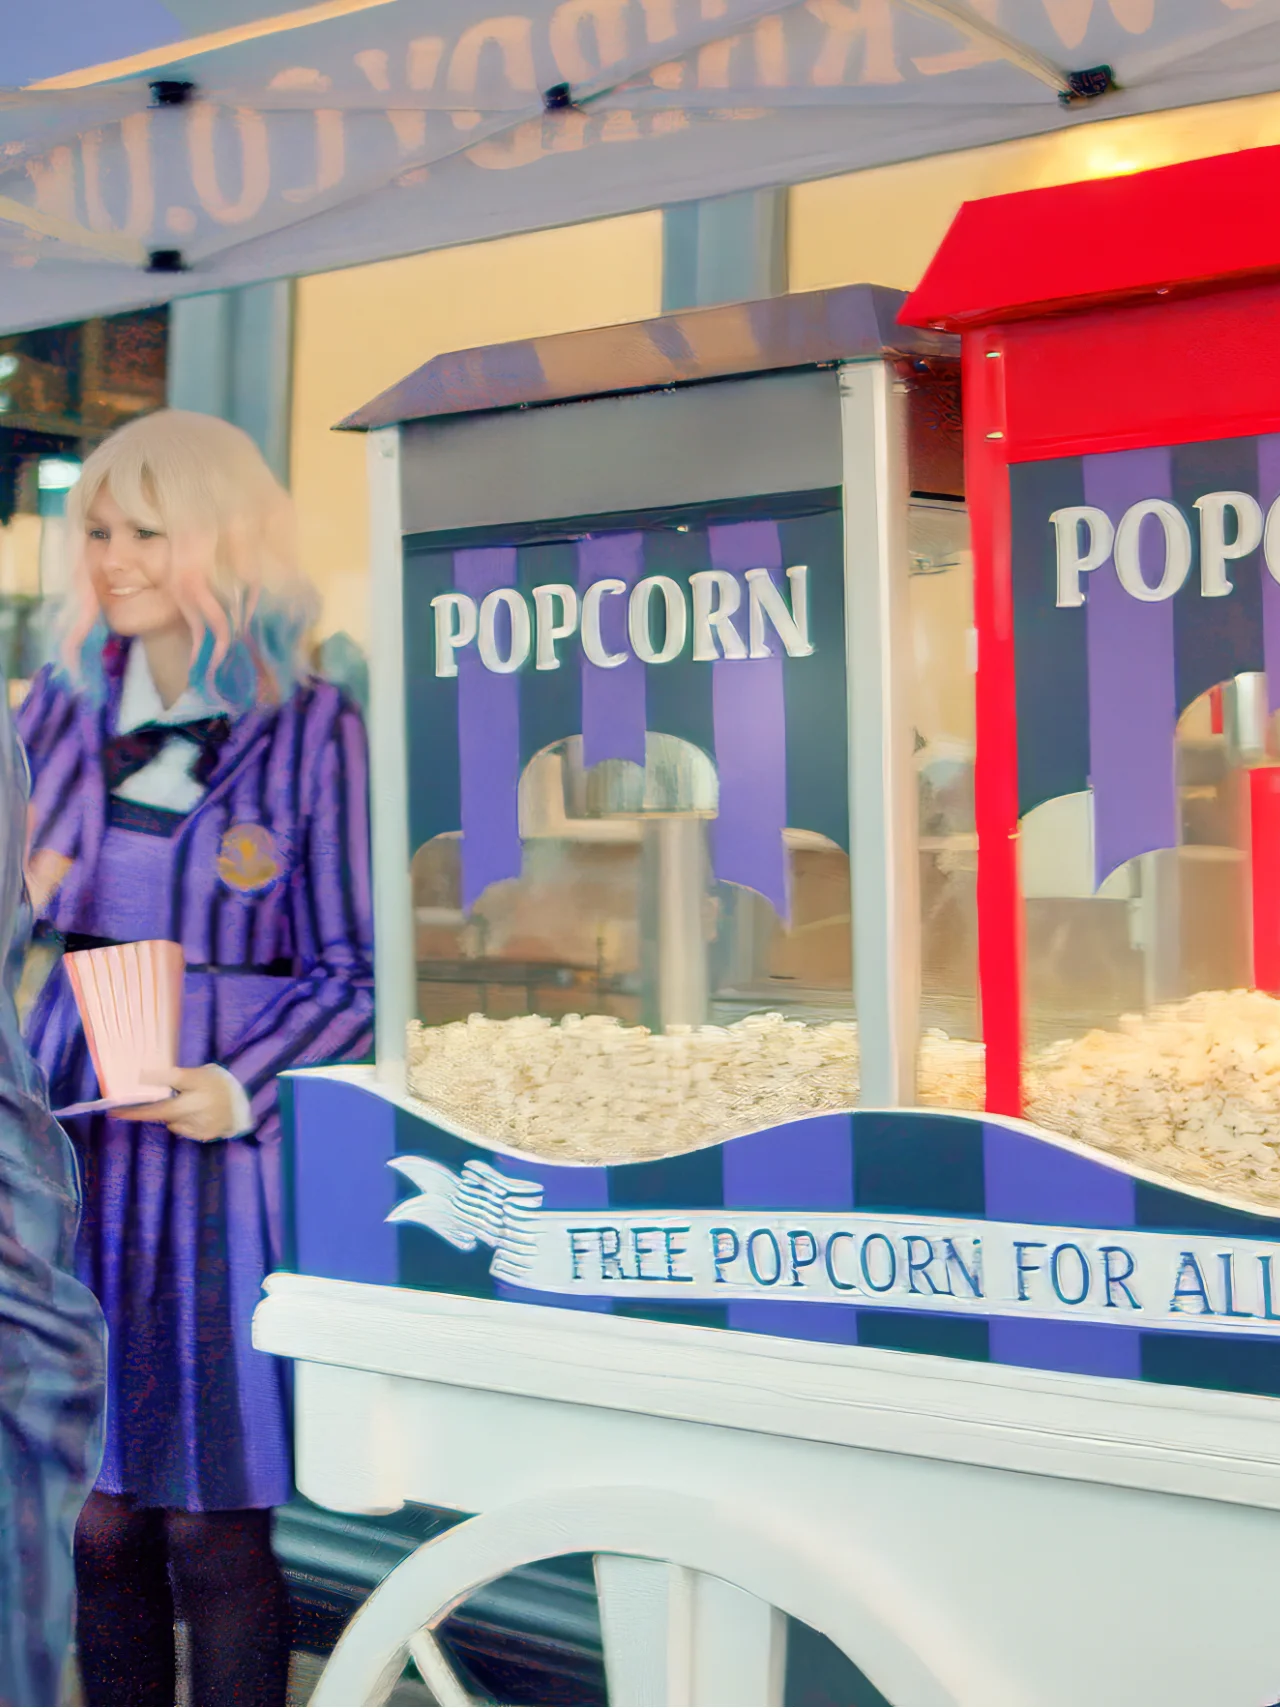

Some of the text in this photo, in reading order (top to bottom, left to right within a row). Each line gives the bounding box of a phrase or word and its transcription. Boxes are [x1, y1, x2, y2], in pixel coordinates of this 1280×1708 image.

[431, 565, 814, 678] POPCORN
[566, 1226, 696, 1282] FREE
[709, 1227, 987, 1299] POPCORN
[1012, 1240, 1142, 1311] FOR
